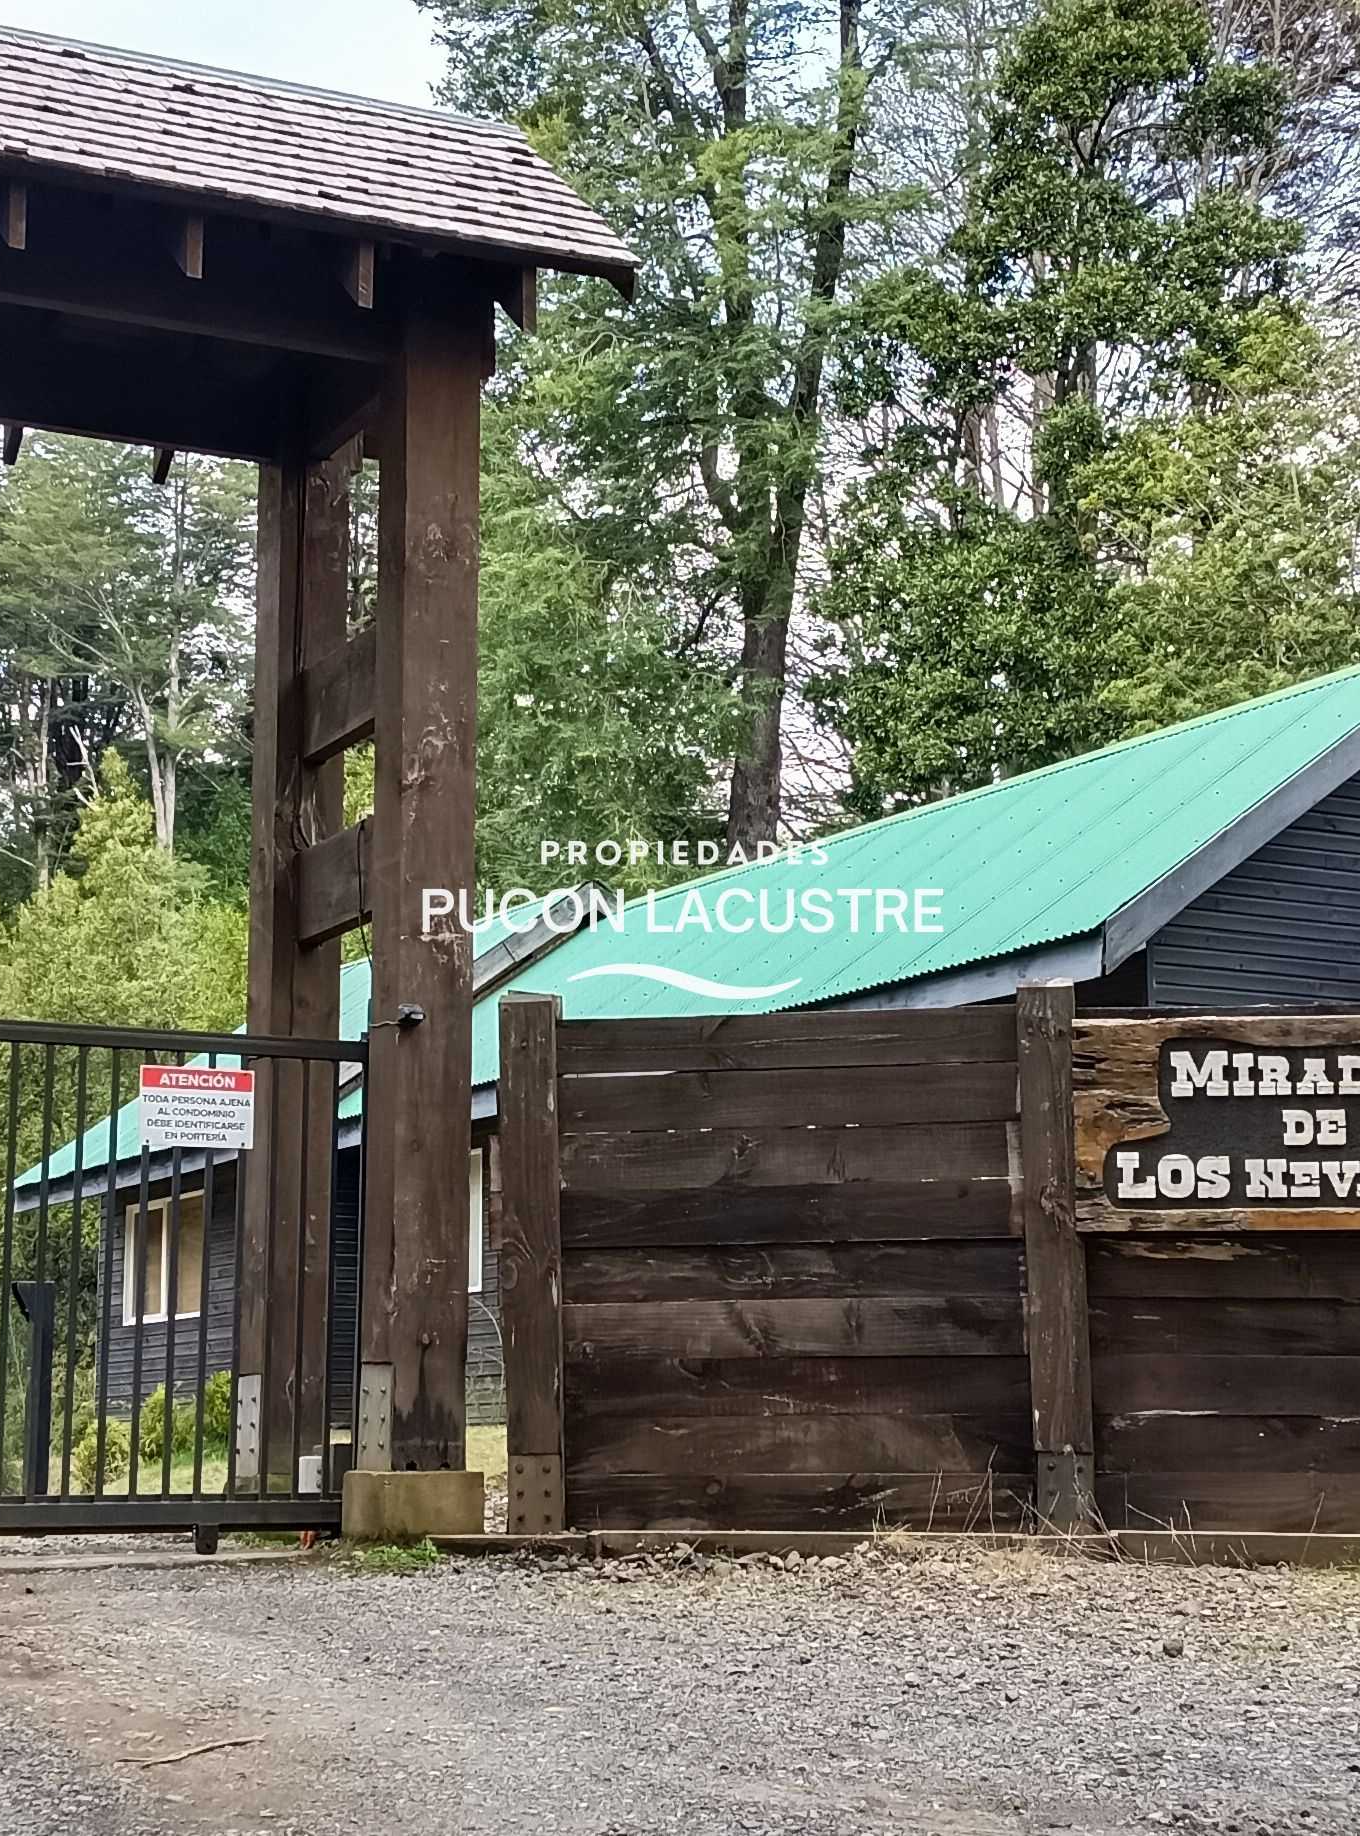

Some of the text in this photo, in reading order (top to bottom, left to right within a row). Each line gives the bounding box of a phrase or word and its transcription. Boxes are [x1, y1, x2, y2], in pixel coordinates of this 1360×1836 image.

[159, 1073, 236, 1089] ATENCIÓN
[142, 1094, 251, 1107] TODA PERSONA AJENA
[157, 1107, 236, 1119] AL CONDOMINIO
[146, 1118, 246, 1131] DEBE IDENTIFICARSE
[1281, 1108, 1348, 1146] DE
[164, 1131, 228, 1142] EN PORTERÍA
[1116, 1151, 1231, 1200] LOS
